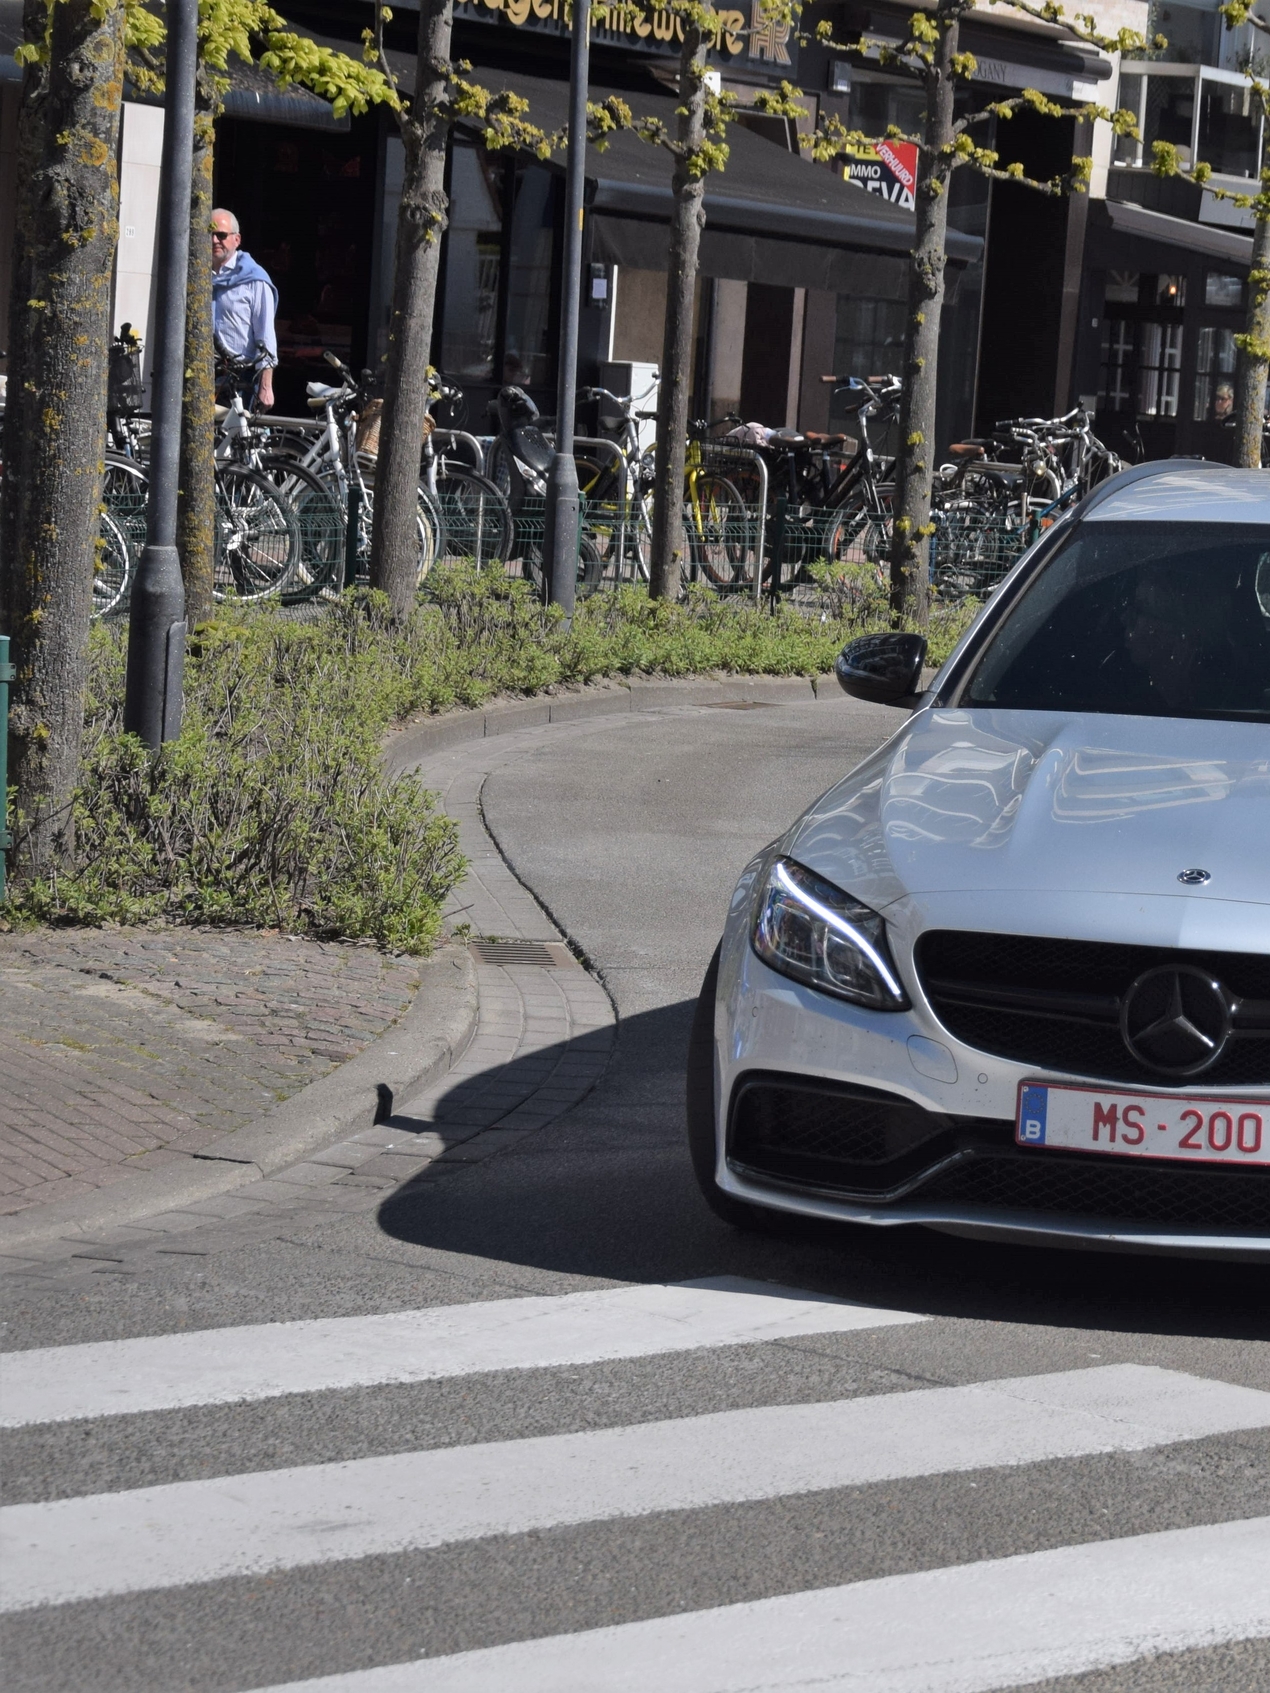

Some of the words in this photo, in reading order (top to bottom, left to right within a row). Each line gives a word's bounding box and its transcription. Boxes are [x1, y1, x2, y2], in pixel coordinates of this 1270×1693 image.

[974, 60, 1006, 82] OGANY
[876, 142, 914, 187] VERHUURD
[1025, 1119, 1042, 1139] B
[1092, 1101, 1263, 1153] MS-200
